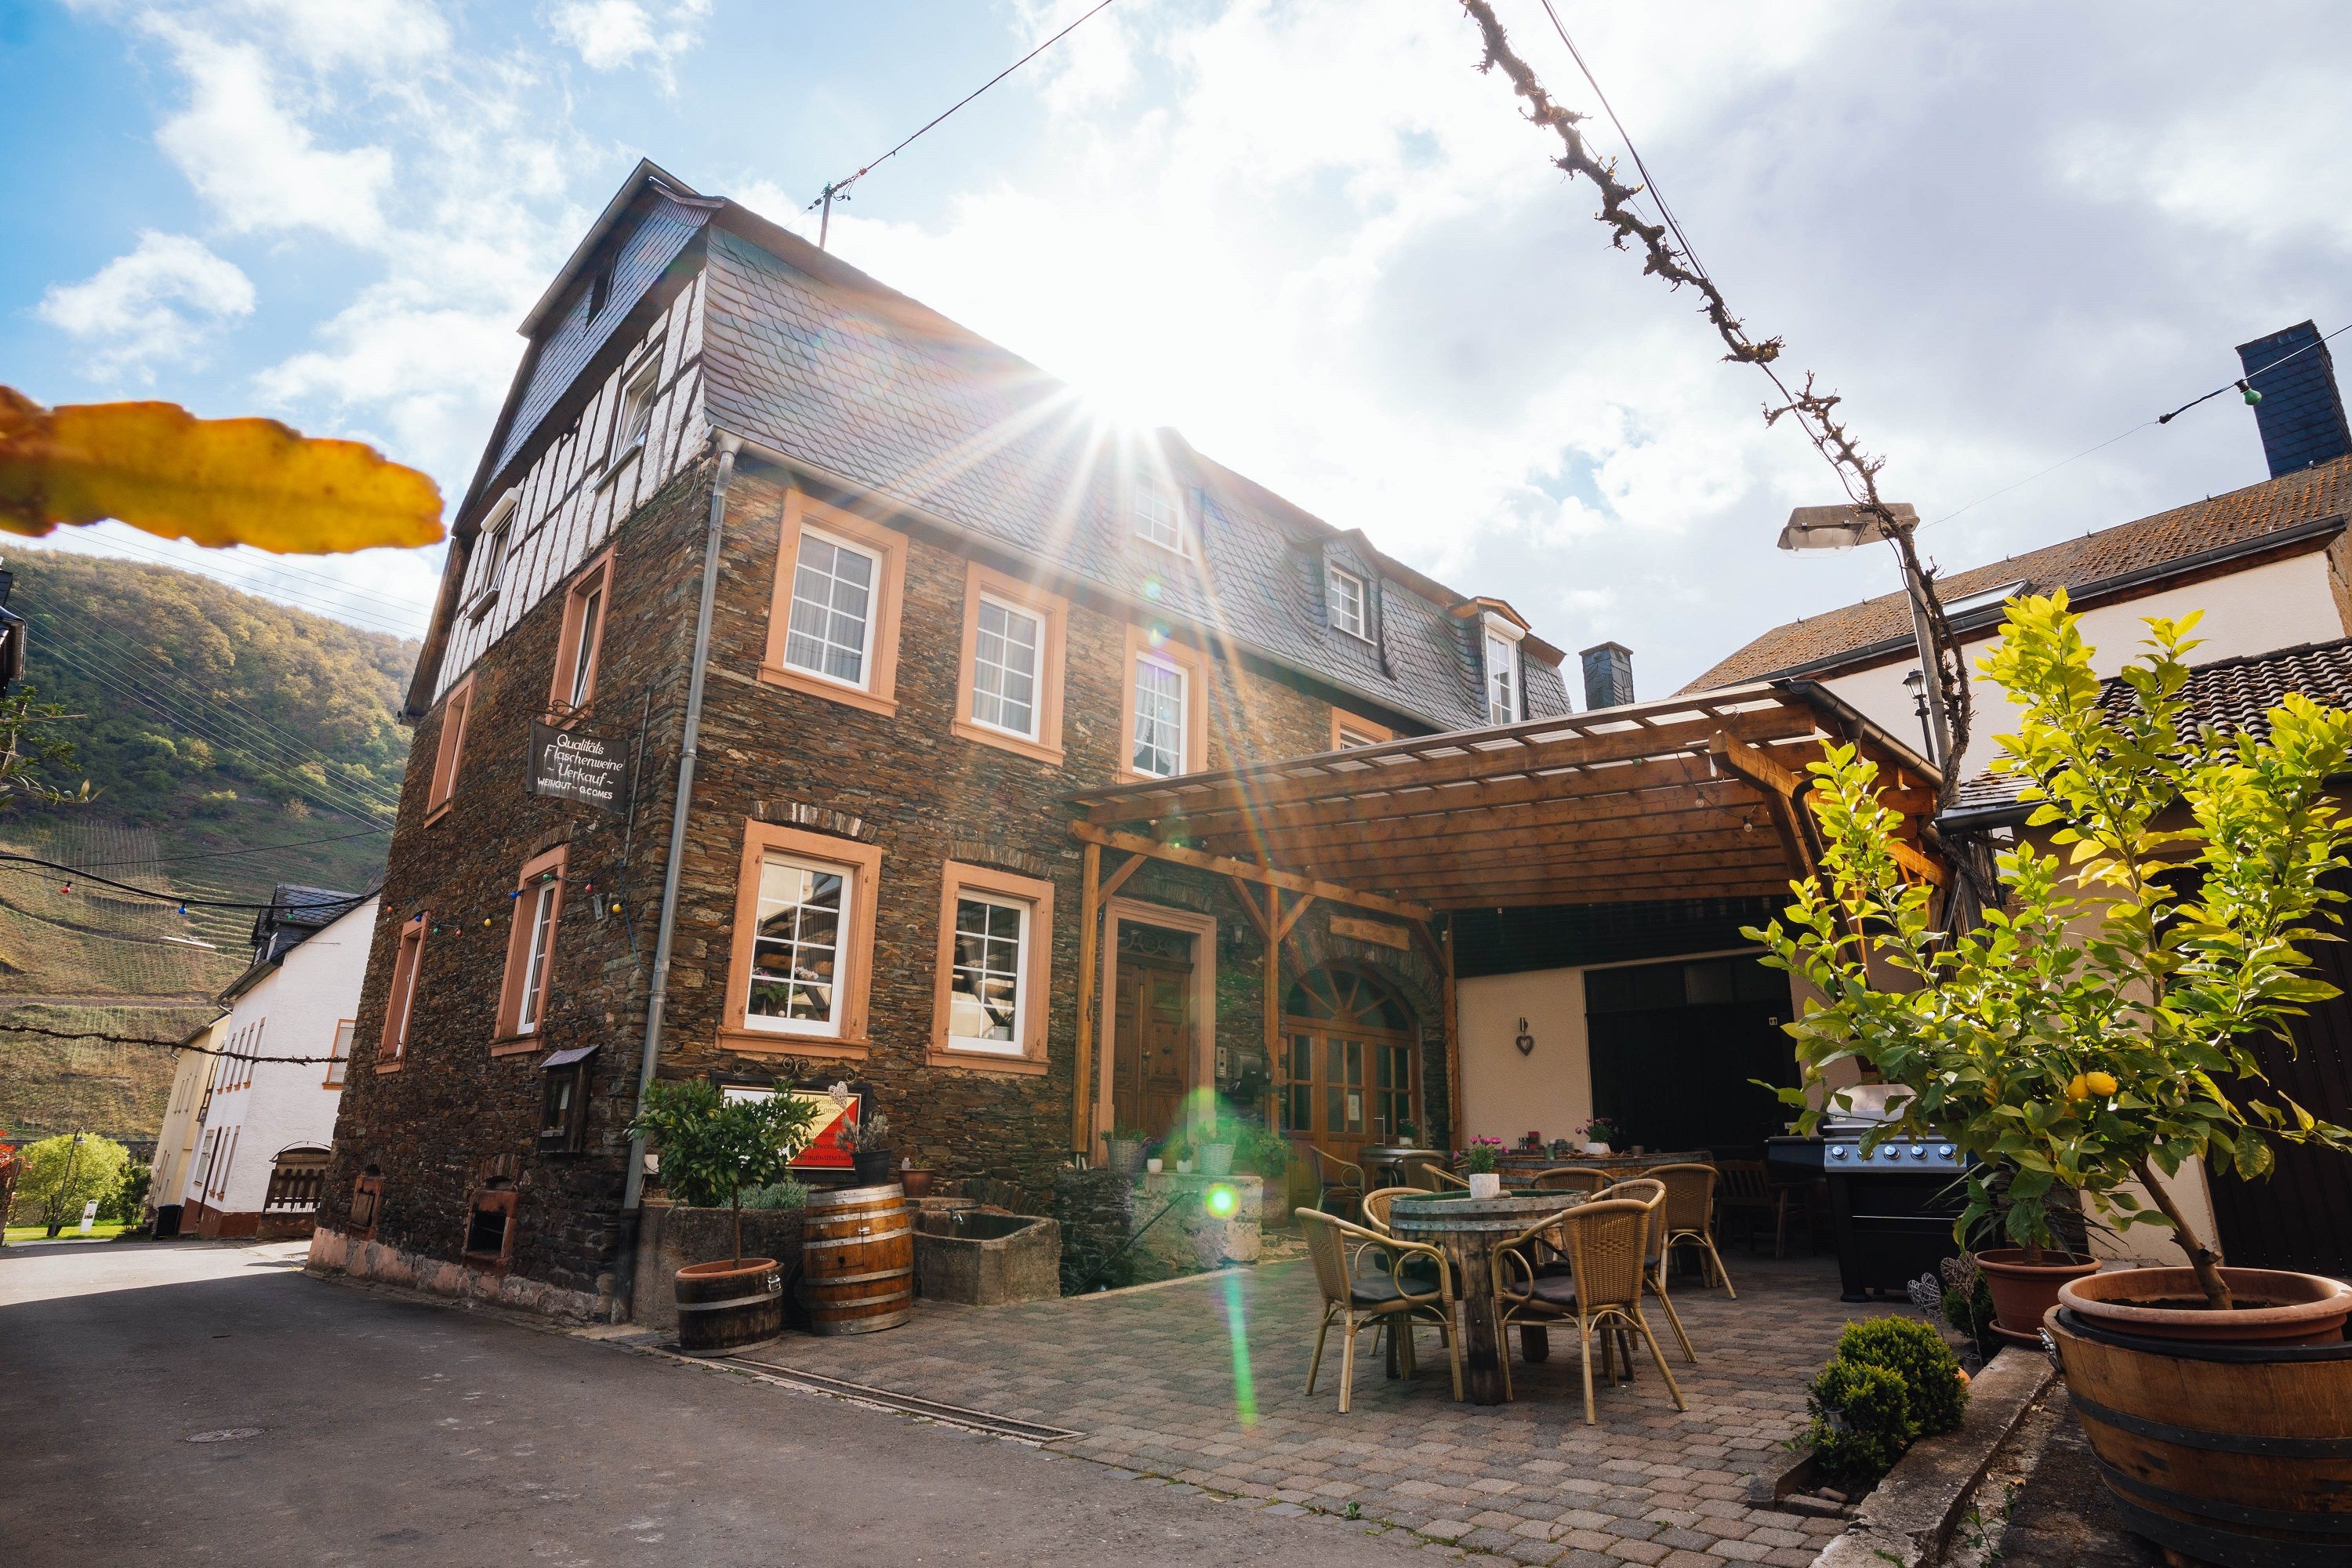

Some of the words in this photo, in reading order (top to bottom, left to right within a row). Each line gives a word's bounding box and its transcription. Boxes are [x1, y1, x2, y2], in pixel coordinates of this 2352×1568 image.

[557, 734, 604, 755] Qualitäts
[544, 744, 623, 771] Flaschenweine
[537, 777, 572, 790] WEINGUT
[558, 762, 608, 786] Verkauf
